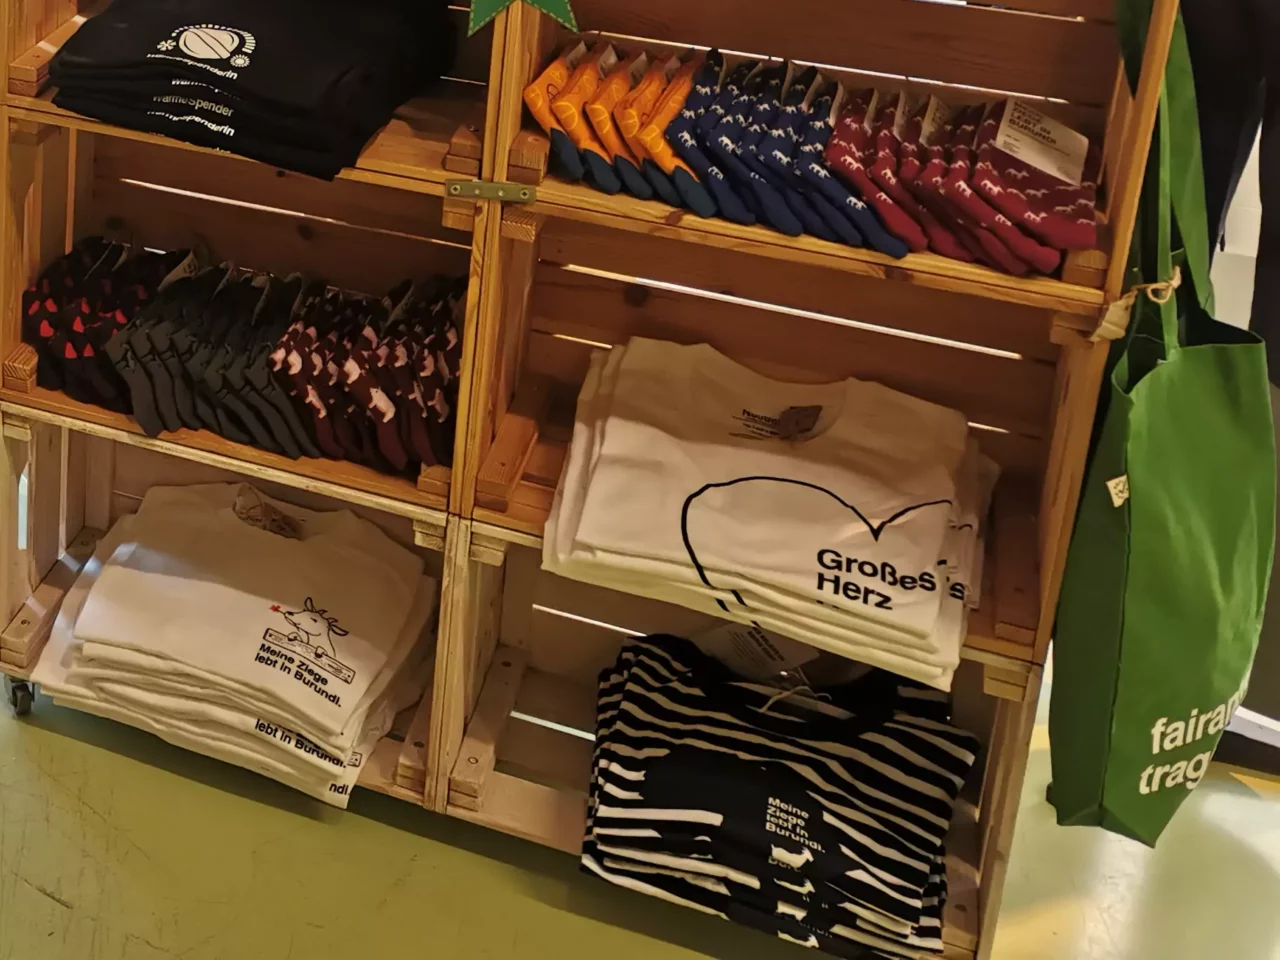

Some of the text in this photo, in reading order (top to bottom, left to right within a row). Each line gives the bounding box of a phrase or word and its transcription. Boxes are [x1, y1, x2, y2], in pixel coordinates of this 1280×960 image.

[817, 549, 937, 591] Großes
[817, 572, 893, 610] Herz
[254, 652, 342, 708] lebt in Burundi.
[259, 643, 329, 686] Meine Ziege
[254, 718, 279, 737] lebt
[766, 805, 806, 827] Ziege
[766, 814, 794, 830] lebt
[768, 797, 810, 819] Meine
[765, 821, 826, 854] Burundi.
